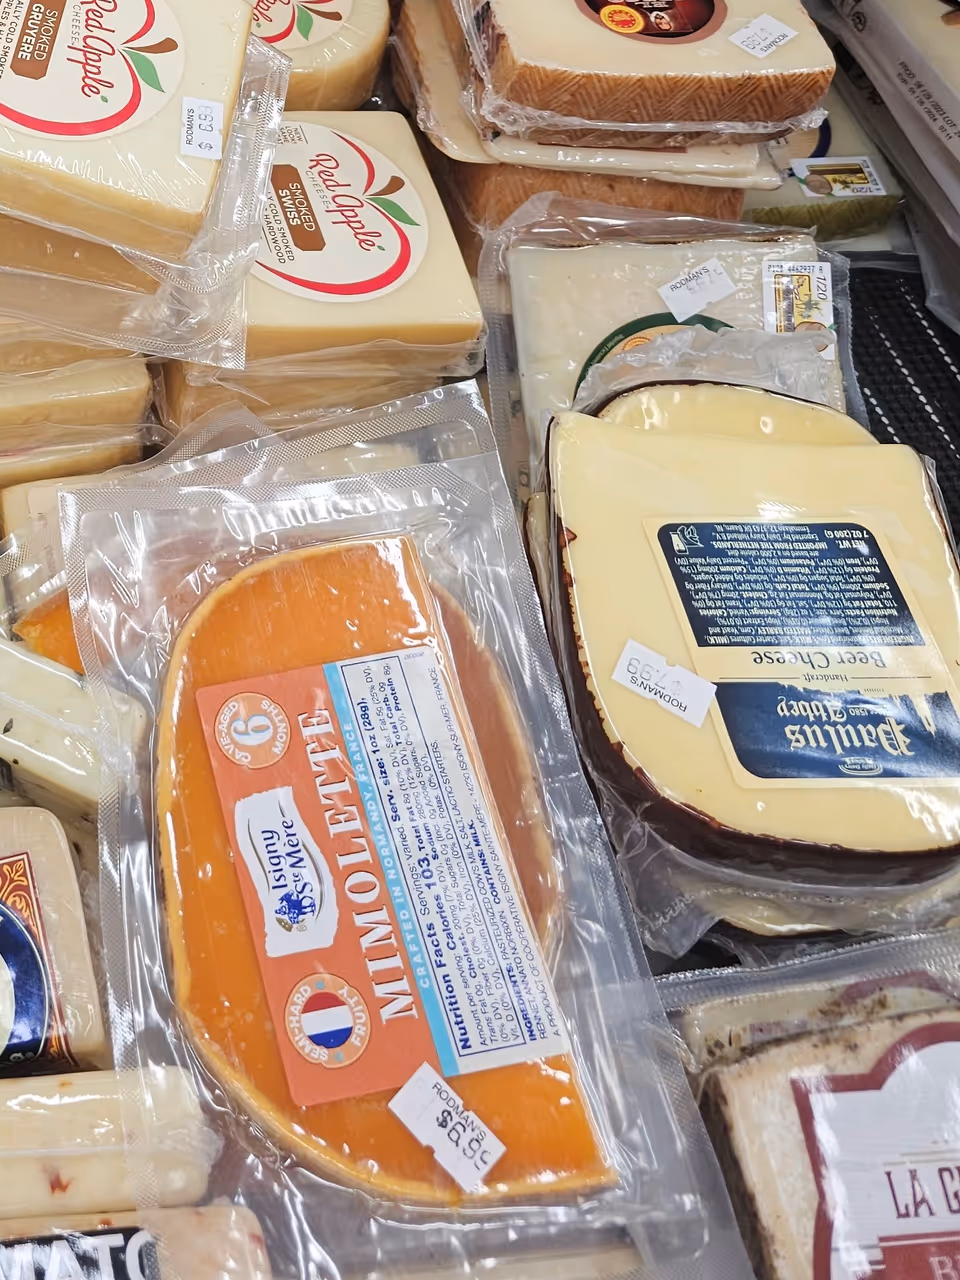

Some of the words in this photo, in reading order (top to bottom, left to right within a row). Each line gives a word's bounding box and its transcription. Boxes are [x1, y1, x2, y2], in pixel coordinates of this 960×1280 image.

[5, 21, 17, 43] COLD
[18, 2, 45, 61] GRUYERE
[33, 9, 59, 61] SMOKED
[66, 33, 116, 98] Apple
[308, 154, 351, 192] Red
[279, 189, 301, 226] SWISS
[289, 182, 316, 231] SMOKED
[325, 194, 382, 252] Apple
[264, 215, 286, 264] HARDWOOD
[669, 266, 709, 292] RODMAN'S
[816, 275, 828, 300] 1/20
[795, 541, 828, 549] IMPORTED
[750, 650, 833, 669] Cheese
[802, 673, 849, 683] Handcraft
[836, 650, 887, 669] Beer
[630, 675, 688, 713] RODMAN'S
[776, 695, 846, 724] Abbey
[230, 714, 273, 746] 6
[260, 699, 288, 756] MONTHS
[344, 722, 368, 782] FRANCE
[784, 716, 914, 757] Paulus
[261, 830, 288, 889] Isigny
[282, 820, 306, 868] Mère
[297, 708, 420, 1025] MIMOLETTE
[426, 922, 447, 968] Facts
[434, 894, 456, 950] Calories
[400, 910, 430, 989] CRAFTED
[288, 984, 328, 1062] SEMI-HARD
[338, 986, 370, 1046] FRUITY
[442, 974, 472, 1050] Nutrition
[507, 962, 537, 1041] INGREDIENTS:
[471, 1007, 488, 1046] Amount
[432, 1082, 486, 1141] RODMAN'S
[884, 1169, 935, 1219] LA
